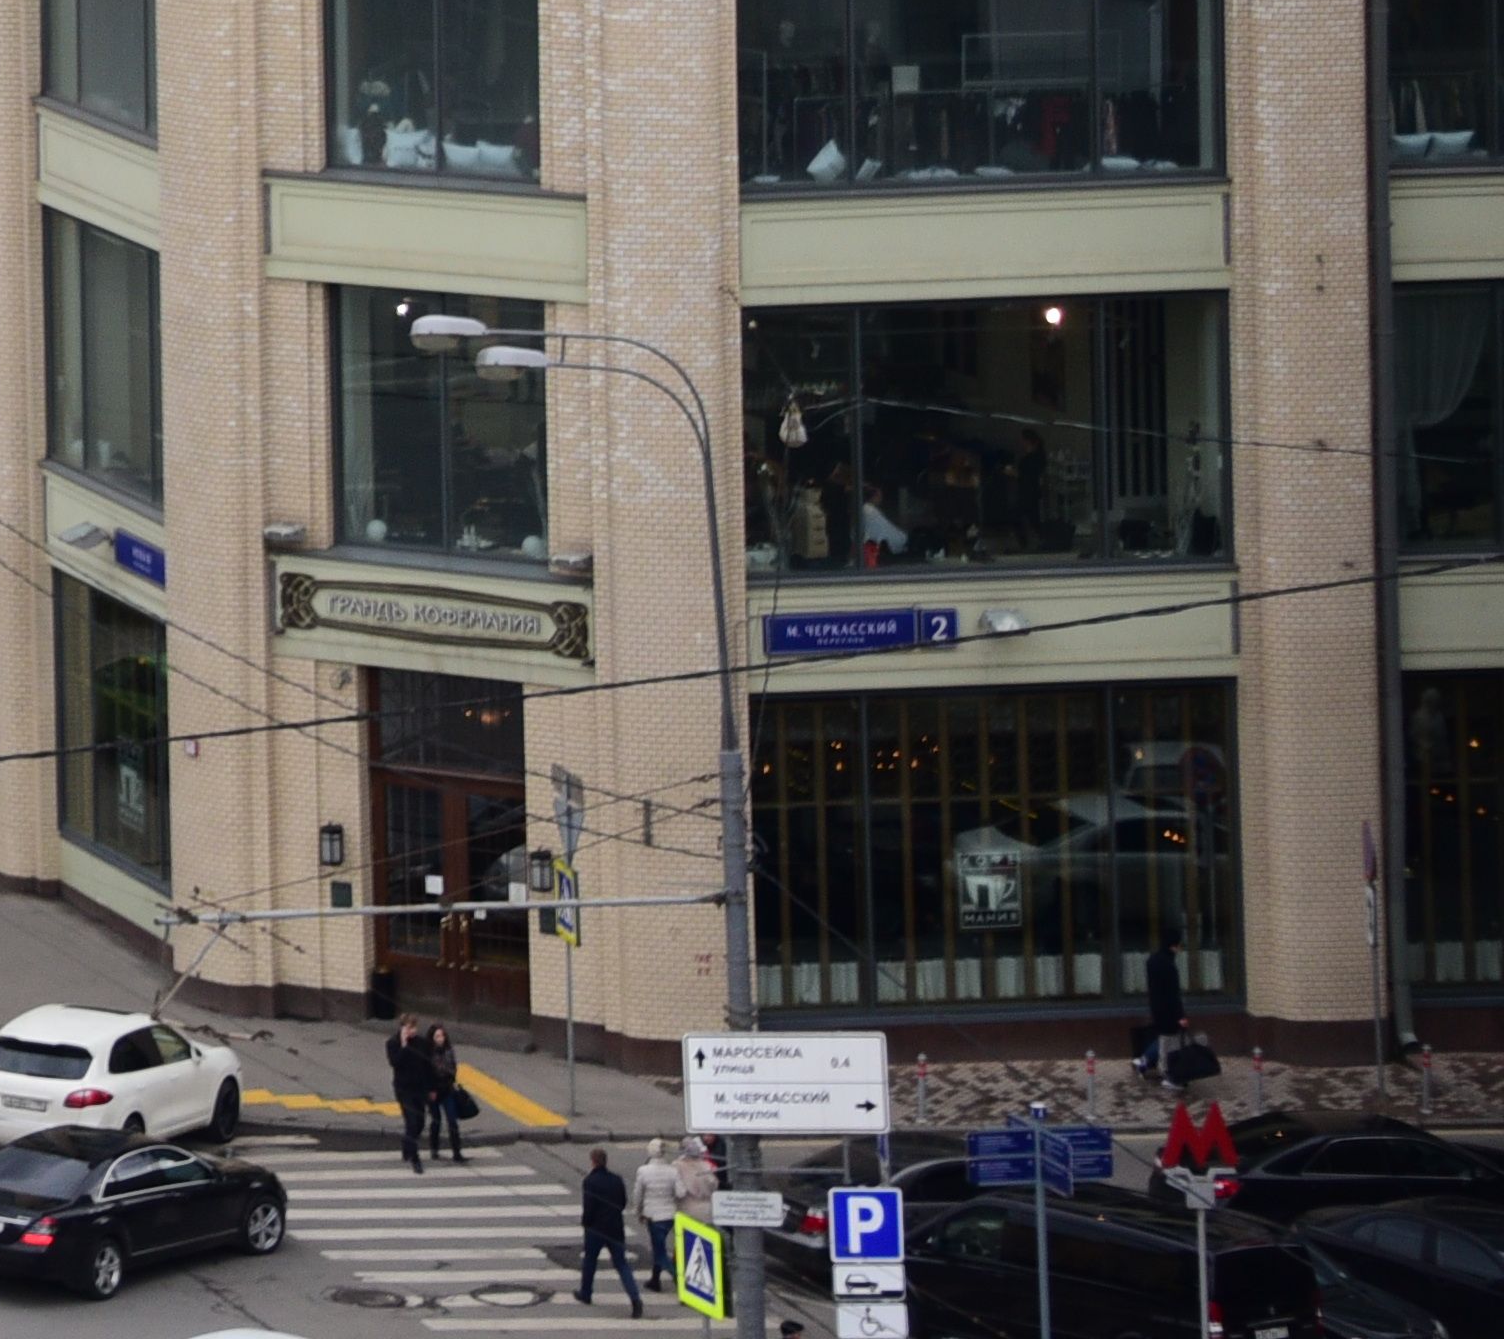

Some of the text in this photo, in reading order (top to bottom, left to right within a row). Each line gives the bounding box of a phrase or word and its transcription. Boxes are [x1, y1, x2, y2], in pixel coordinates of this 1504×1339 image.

[411, 602, 540, 636] КОФЕМАНИЯ
[804, 620, 897, 637] ЧЕРКАССКИЙ
[931, 616, 949, 642] 2
[712, 1046, 803, 1060] МАРОСЕЙКА
[713, 1065, 755, 1076] улица
[733, 1091, 830, 1105] ЧЕРКАССКИЙ
[715, 1110, 780, 1122] переулок
[847, 1196, 885, 1254] P
